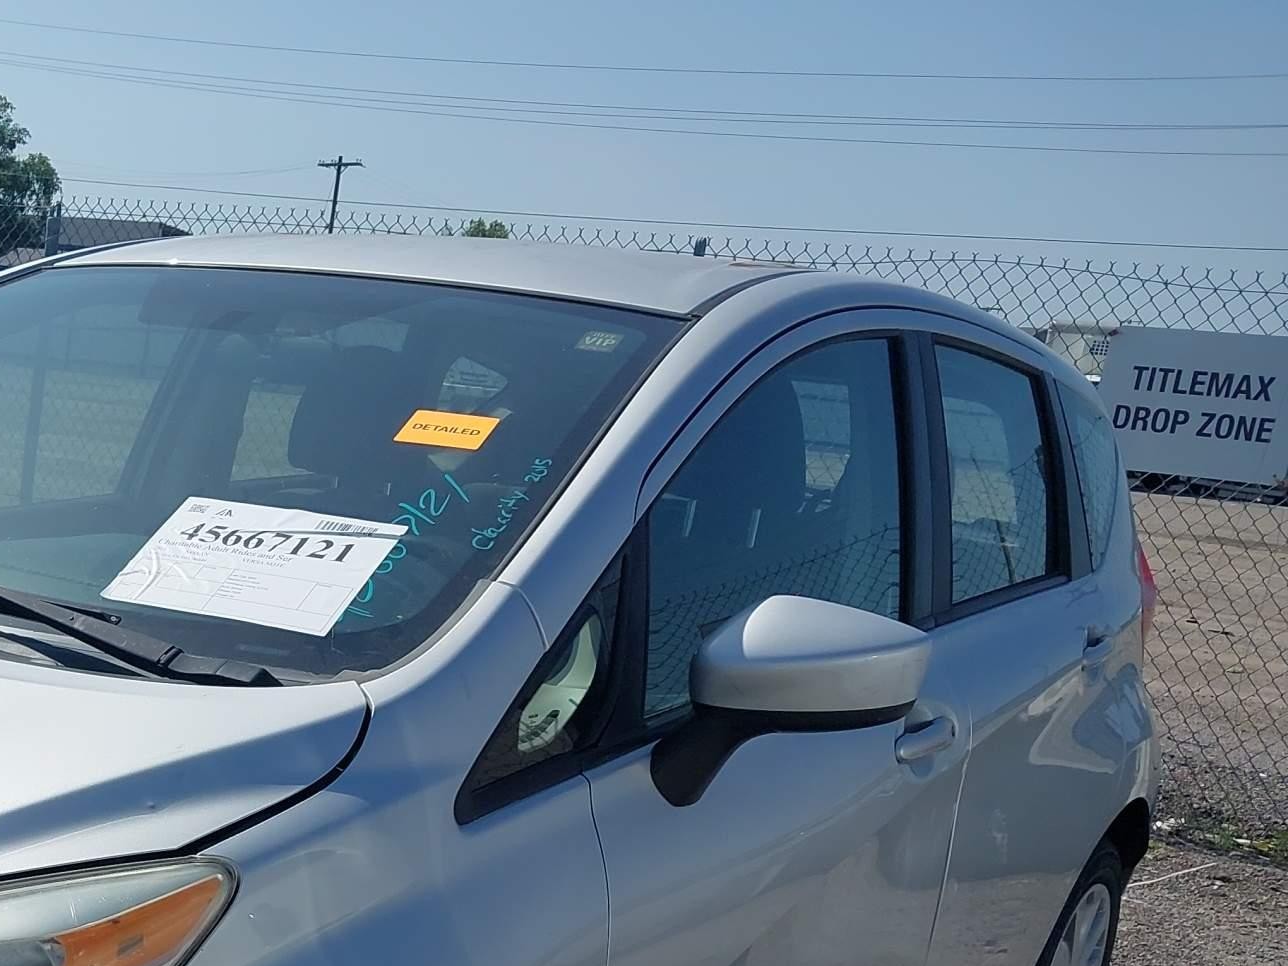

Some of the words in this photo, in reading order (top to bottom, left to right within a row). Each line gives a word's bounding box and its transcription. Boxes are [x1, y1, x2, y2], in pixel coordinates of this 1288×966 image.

[1133, 366, 1276, 402] TITLEMAX
[412, 423, 481, 436] DETAILED
[1113, 404, 1190, 434] DROP
[1195, 412, 1276, 443] ZONE
[180, 522, 356, 563] 45667121
[206, 543, 231, 554] Adult
[232, 547, 257, 557] Rides
[257, 551, 277, 560] and
